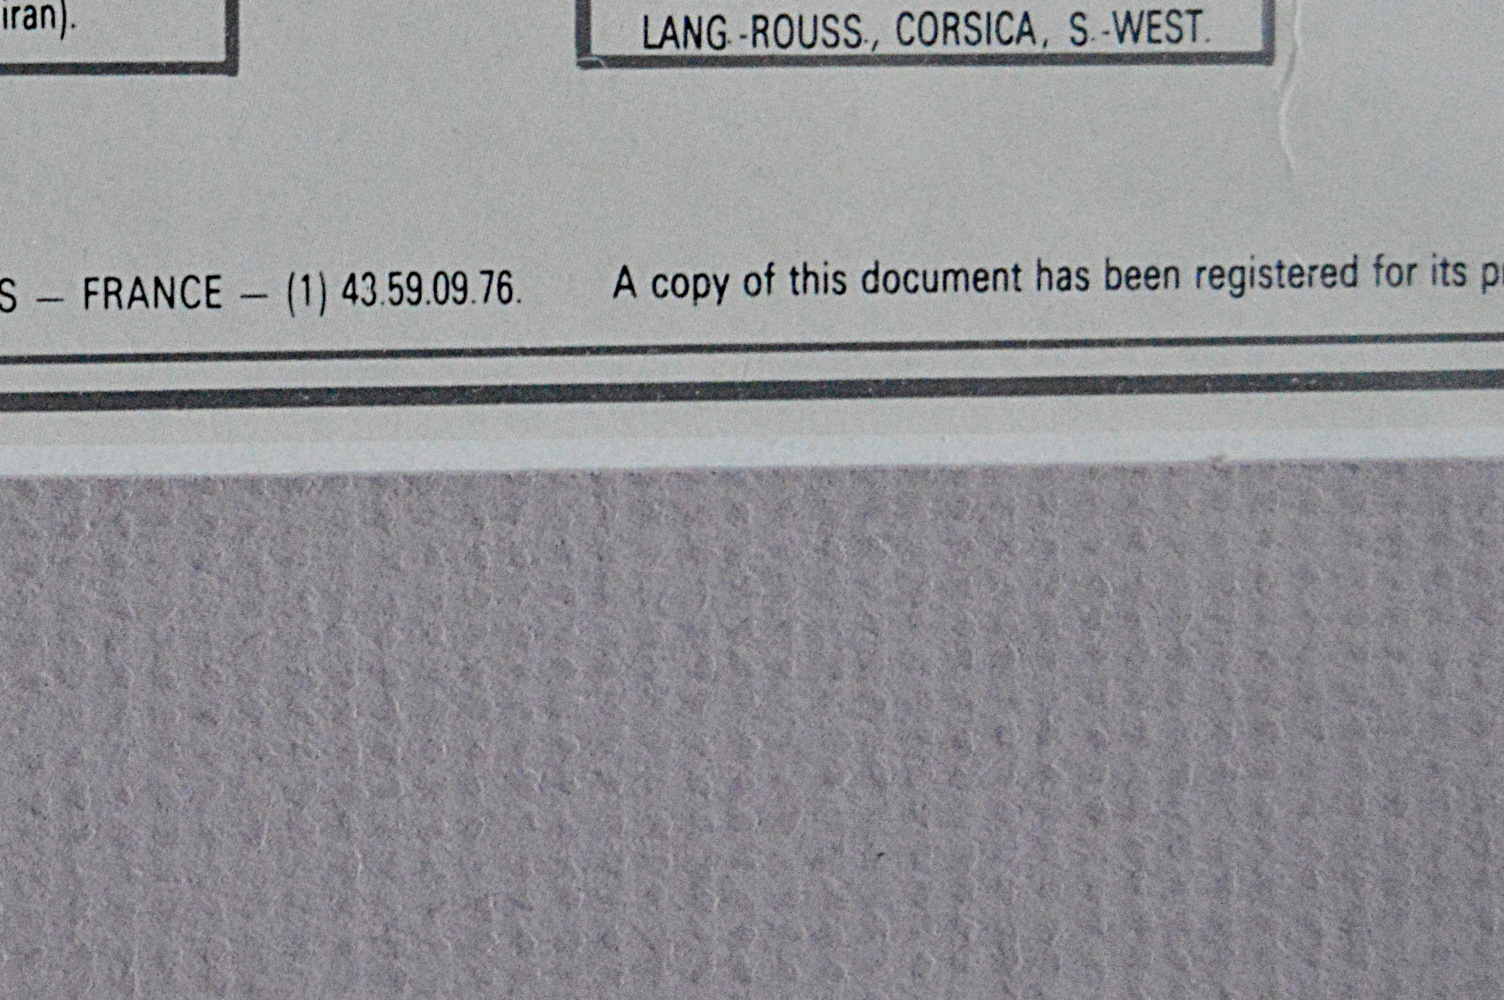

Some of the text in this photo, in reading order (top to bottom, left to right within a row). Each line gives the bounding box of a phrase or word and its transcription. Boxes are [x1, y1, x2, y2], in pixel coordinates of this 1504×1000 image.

[895, 9, 1049, 49] CORSICA,
[83, 273, 223, 311] FRANCE
[287, 271, 327, 318] (1)
[612, 252, 1504, 307] A copy of this document has been registered for its p
